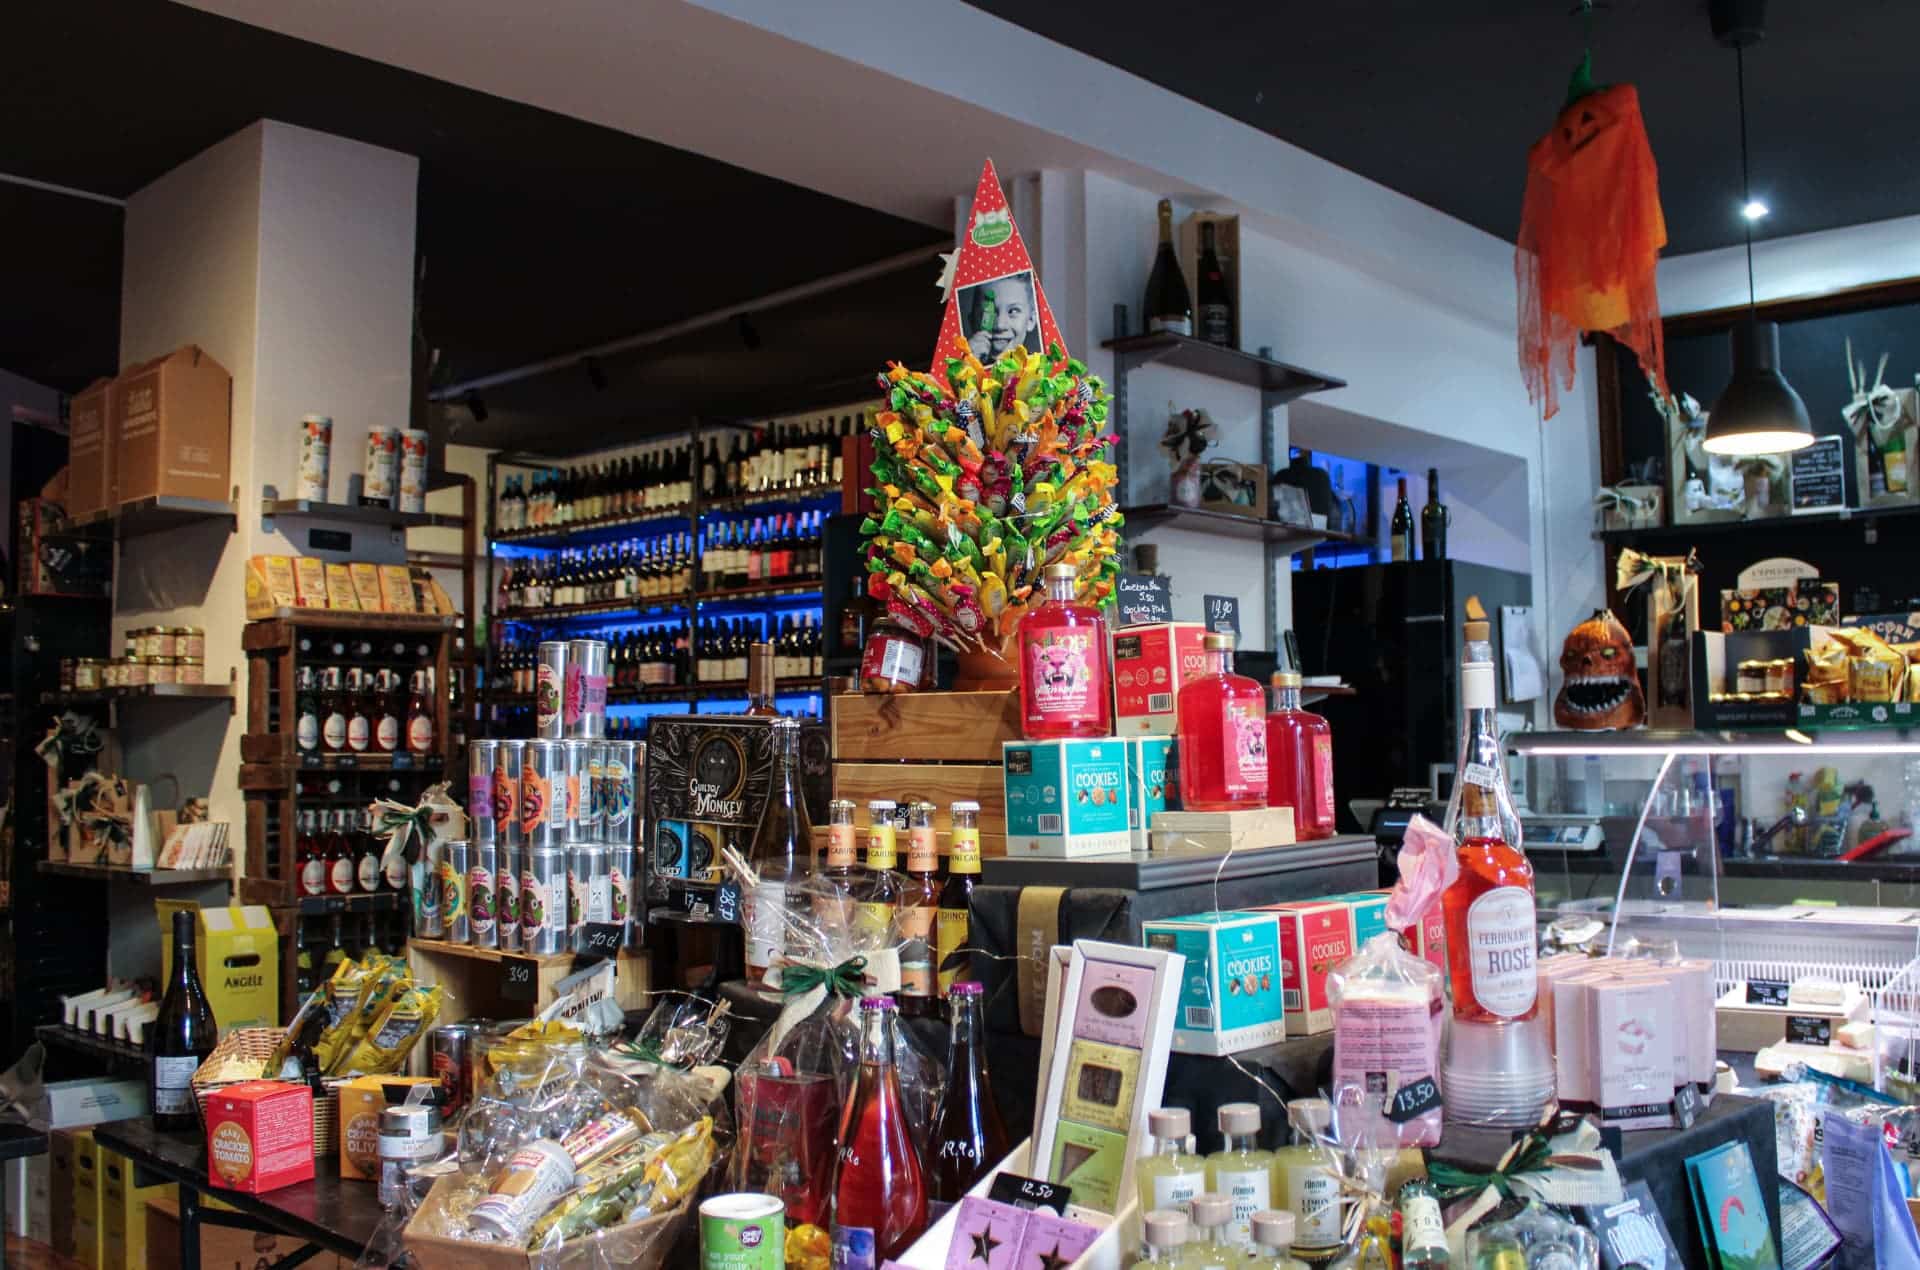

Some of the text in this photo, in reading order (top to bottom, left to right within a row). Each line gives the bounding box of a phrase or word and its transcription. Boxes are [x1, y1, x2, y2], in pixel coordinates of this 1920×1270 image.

[1075, 771, 1119, 787] COOKIES
[695, 793, 743, 818] MONKEY
[1312, 941, 1346, 960] COOKIES
[1227, 955, 1272, 977] COOKIES
[347, 1140, 377, 1153] OLIV
